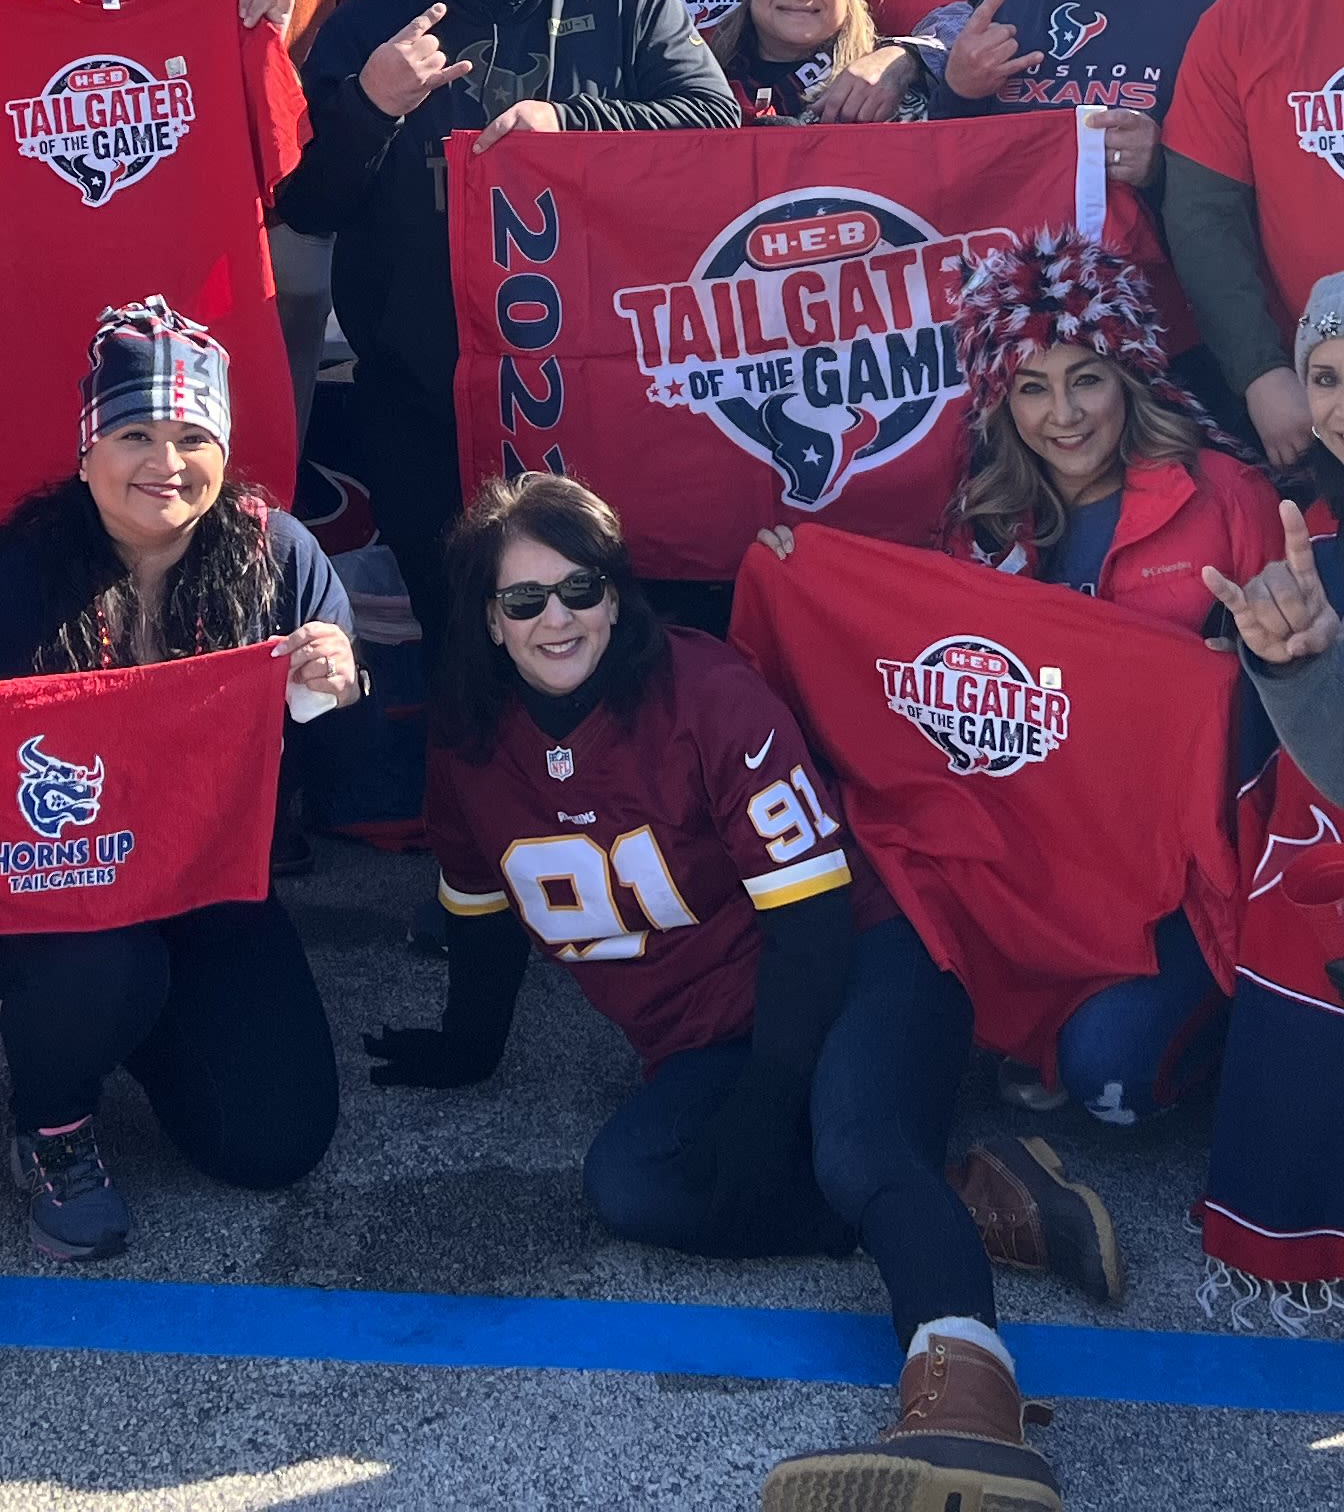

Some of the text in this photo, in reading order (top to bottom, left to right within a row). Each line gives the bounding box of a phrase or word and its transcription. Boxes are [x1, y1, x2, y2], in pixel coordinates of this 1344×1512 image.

[1027, 63, 1161, 81] USTON
[9, 82, 192, 139] TAILGATER
[996, 78, 1157, 109] EXANS
[39, 121, 174, 160] OF THE GAME
[1318, 136, 1336, 151] OF
[688, 369, 723, 400] OF
[736, 356, 793, 394] THE
[879, 662, 1066, 735] TAILGATER
[906, 704, 1043, 757] OF THE GAME
[551, 761, 569, 774] NFL
[746, 763, 840, 864] 91
[96, 830, 135, 865] UP
[8, 866, 116, 894] TAILGATERS
[500, 823, 701, 963] 91
